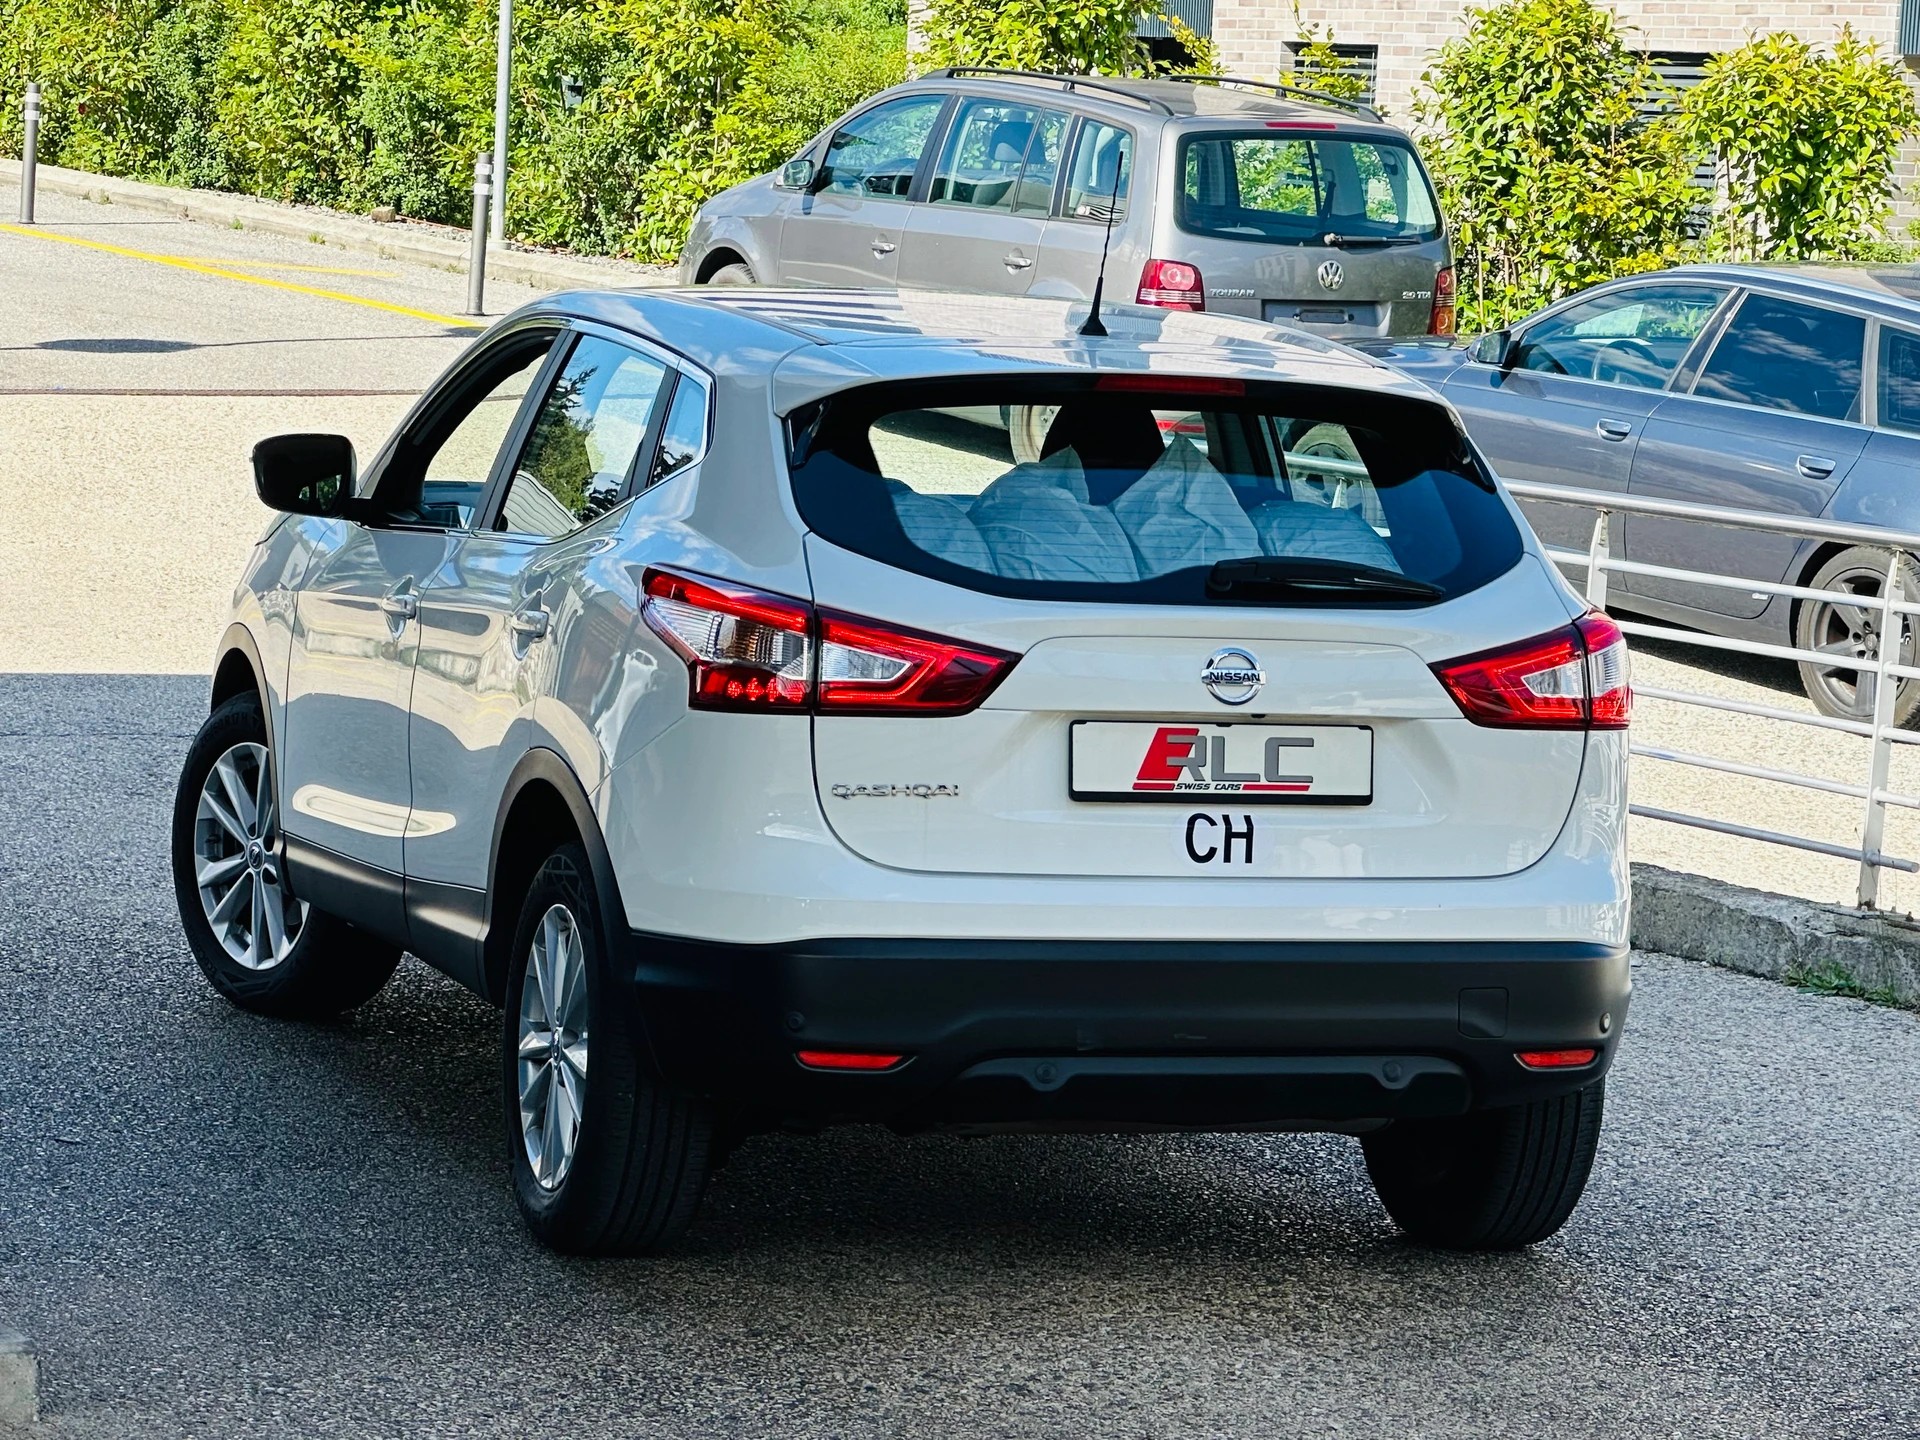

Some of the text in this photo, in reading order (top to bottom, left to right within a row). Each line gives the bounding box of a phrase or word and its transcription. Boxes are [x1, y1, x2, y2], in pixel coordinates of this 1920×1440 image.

[1210, 288, 1255, 297] TOURAN
[1416, 290, 1432, 300] TDI
[1209, 672, 1261, 682] NISSAN
[832, 783, 959, 799] QASHQAI
[1175, 782, 1243, 792] SWISS CARS
[1185, 812, 1255, 864] CH
